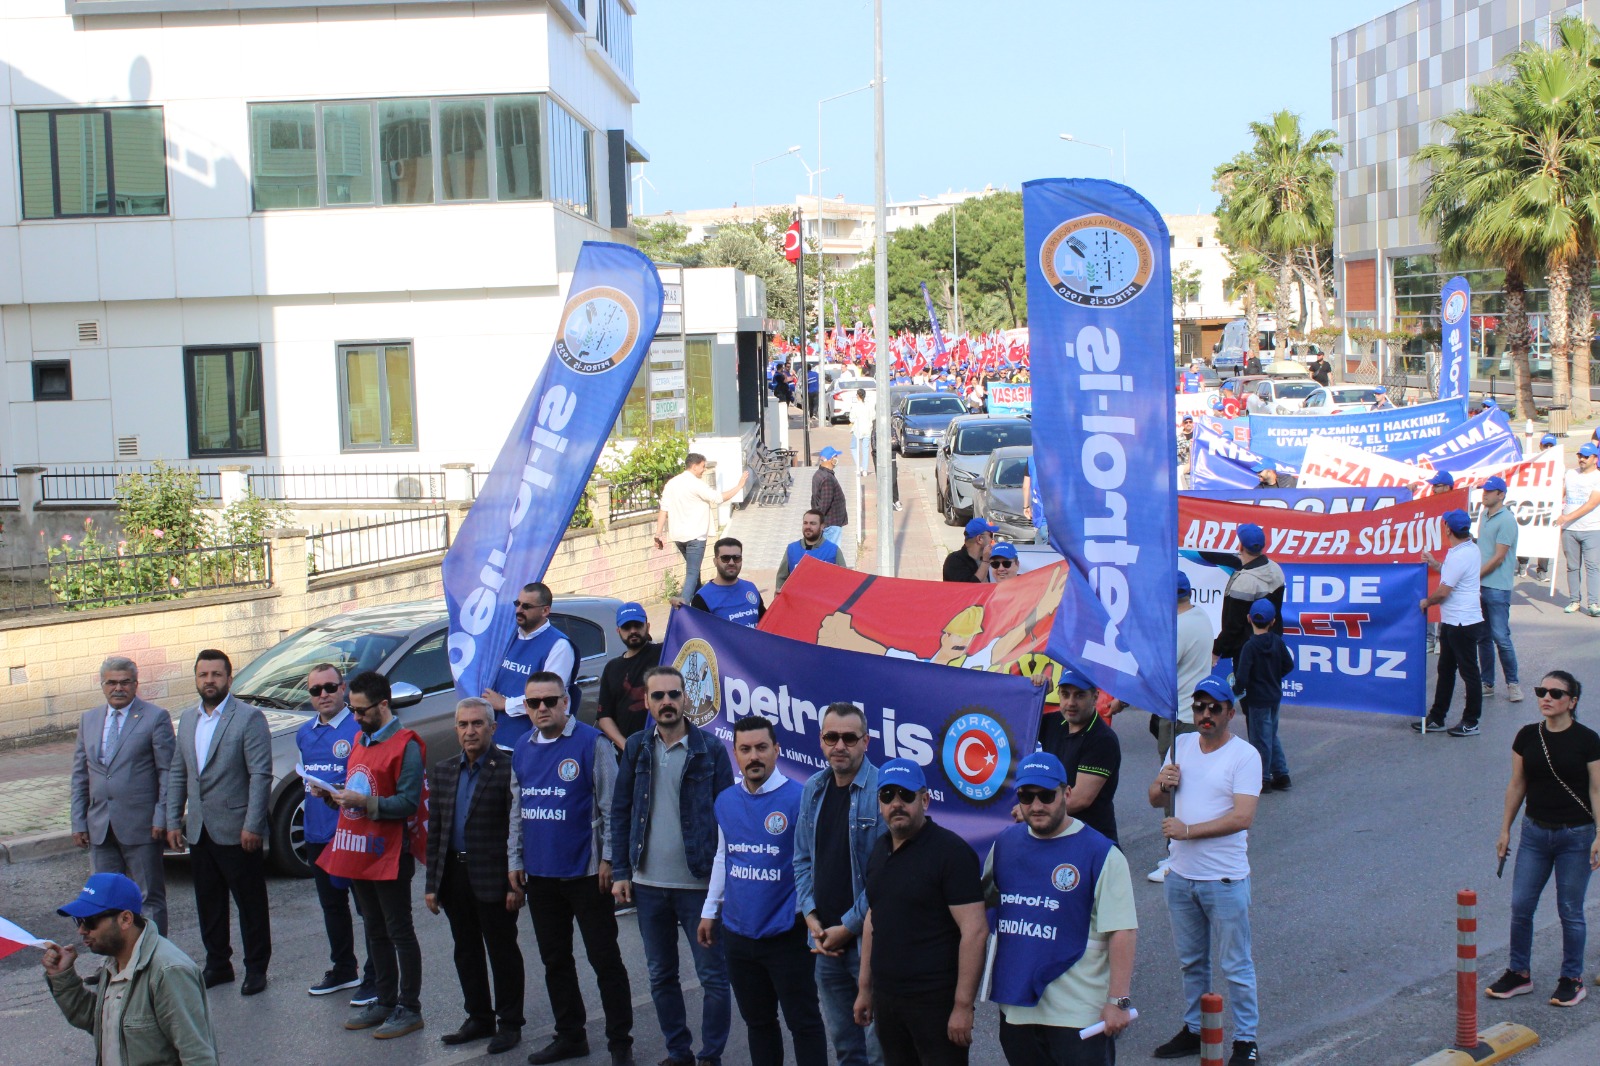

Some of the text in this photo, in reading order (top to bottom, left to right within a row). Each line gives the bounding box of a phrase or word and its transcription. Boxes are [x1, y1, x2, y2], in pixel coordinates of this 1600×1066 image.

[1267, 412, 1450, 437] KIDEM TAZMİNATI HAKKIMIZ,
[1366, 434, 1383, 445] EL
[1385, 426, 1441, 443] UZATANI
[1266, 528, 1350, 555] YETER
[1355, 511, 1442, 556] SÖZÜN
[785, 746, 814, 765] KİMYA
[958, 781, 992, 798] 1952
[728, 842, 780, 856] petrol-iş
[1001, 893, 1060, 911] petrol-iş
